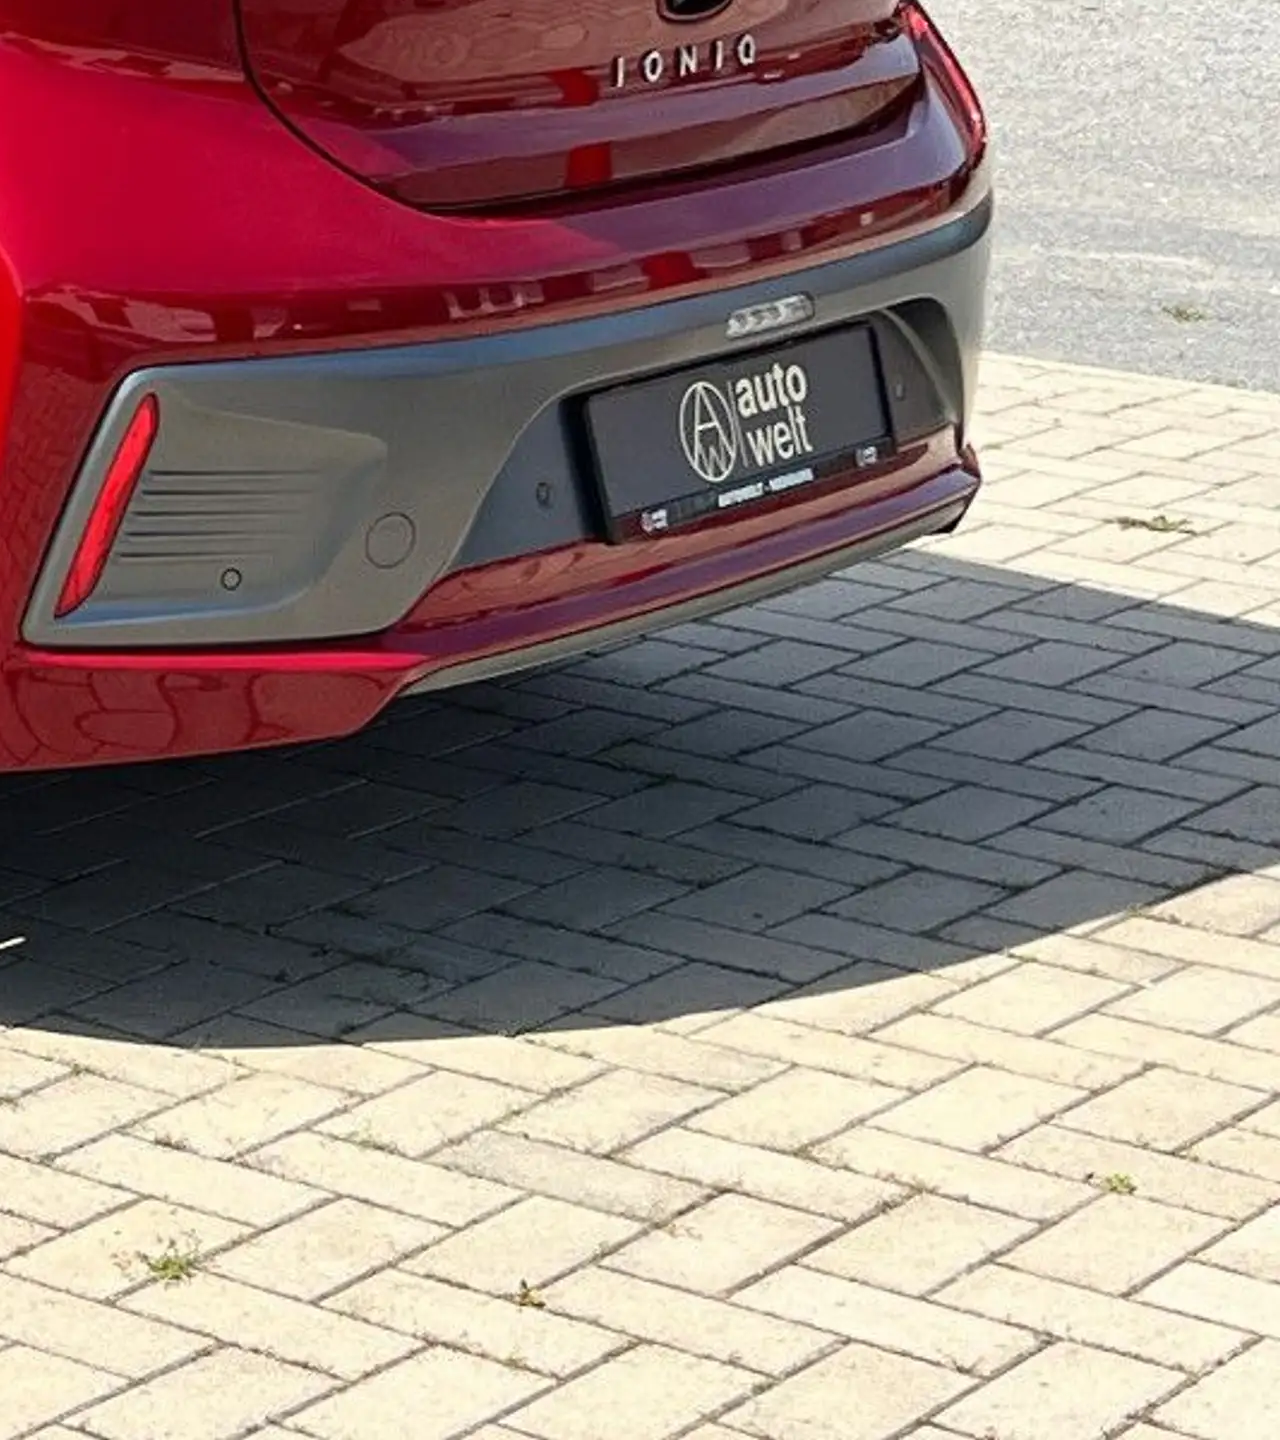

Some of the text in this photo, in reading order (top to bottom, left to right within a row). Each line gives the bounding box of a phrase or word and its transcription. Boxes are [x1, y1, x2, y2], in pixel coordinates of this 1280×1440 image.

[617, 34, 756, 88] IONIQ
[735, 362, 807, 418] auto
[745, 405, 813, 467] welt
